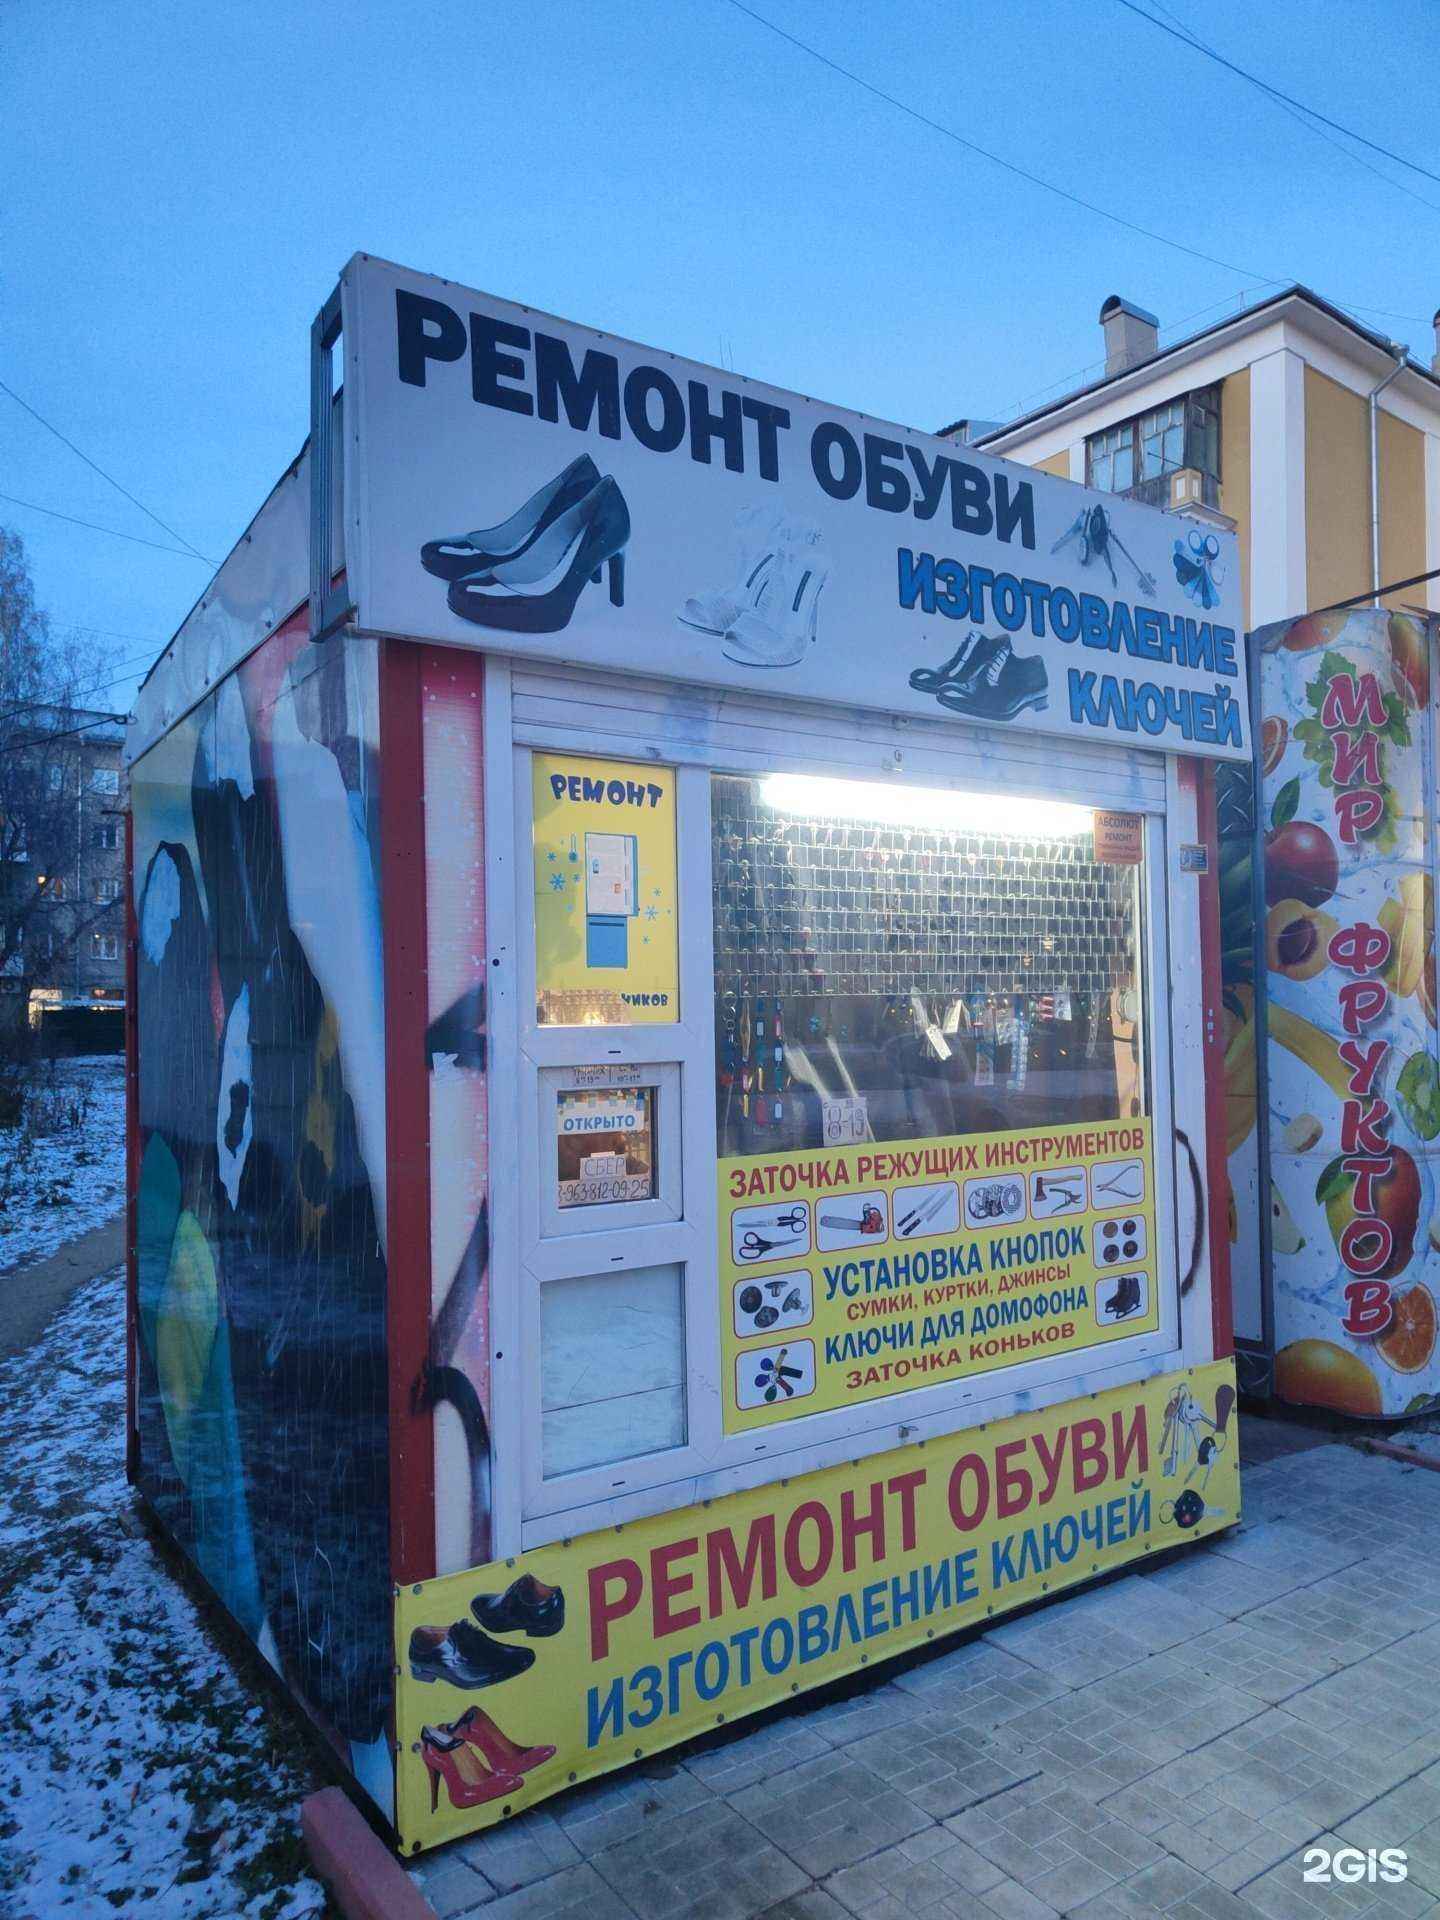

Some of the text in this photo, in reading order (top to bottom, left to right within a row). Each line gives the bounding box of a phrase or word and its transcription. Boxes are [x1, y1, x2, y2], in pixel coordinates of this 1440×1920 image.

[395, 289, 1035, 550] РЕМОНТ ОБУВИ
[898, 547, 1238, 678] ИЗГОТОВЛЕНИЕ
[1067, 667, 1242, 749] КЛЮЧЕЙ
[550, 774, 663, 808] РЕМОНТ
[1320, 671, 1394, 1336] МИР ФРУКТОВ
[564, 1115, 635, 1131] ОТКРЫТО
[729, 1127, 1145, 1198] ЗАТОЧКА РЕЖУЩИХ ИНСТРУМЕНТОВ
[824, 1225, 1086, 1300] УСТАНОВКА КНОПОК
[846, 1263, 1071, 1321] СУМКИ, КУРТКИ, ДЖИНСЫ
[825, 1285, 1088, 1364] КЛЮЧИ ДЛЯ ДОМОФОНА
[846, 1322, 1075, 1389] ЗАТОЧКА КОНЬКОВ
[587, 1404, 1150, 1662] РЕМОНТ ОБУВИ
[586, 1482, 1152, 1748] ИЗГОТОВЛЕНИЕ КЛЮЧЕЙ
